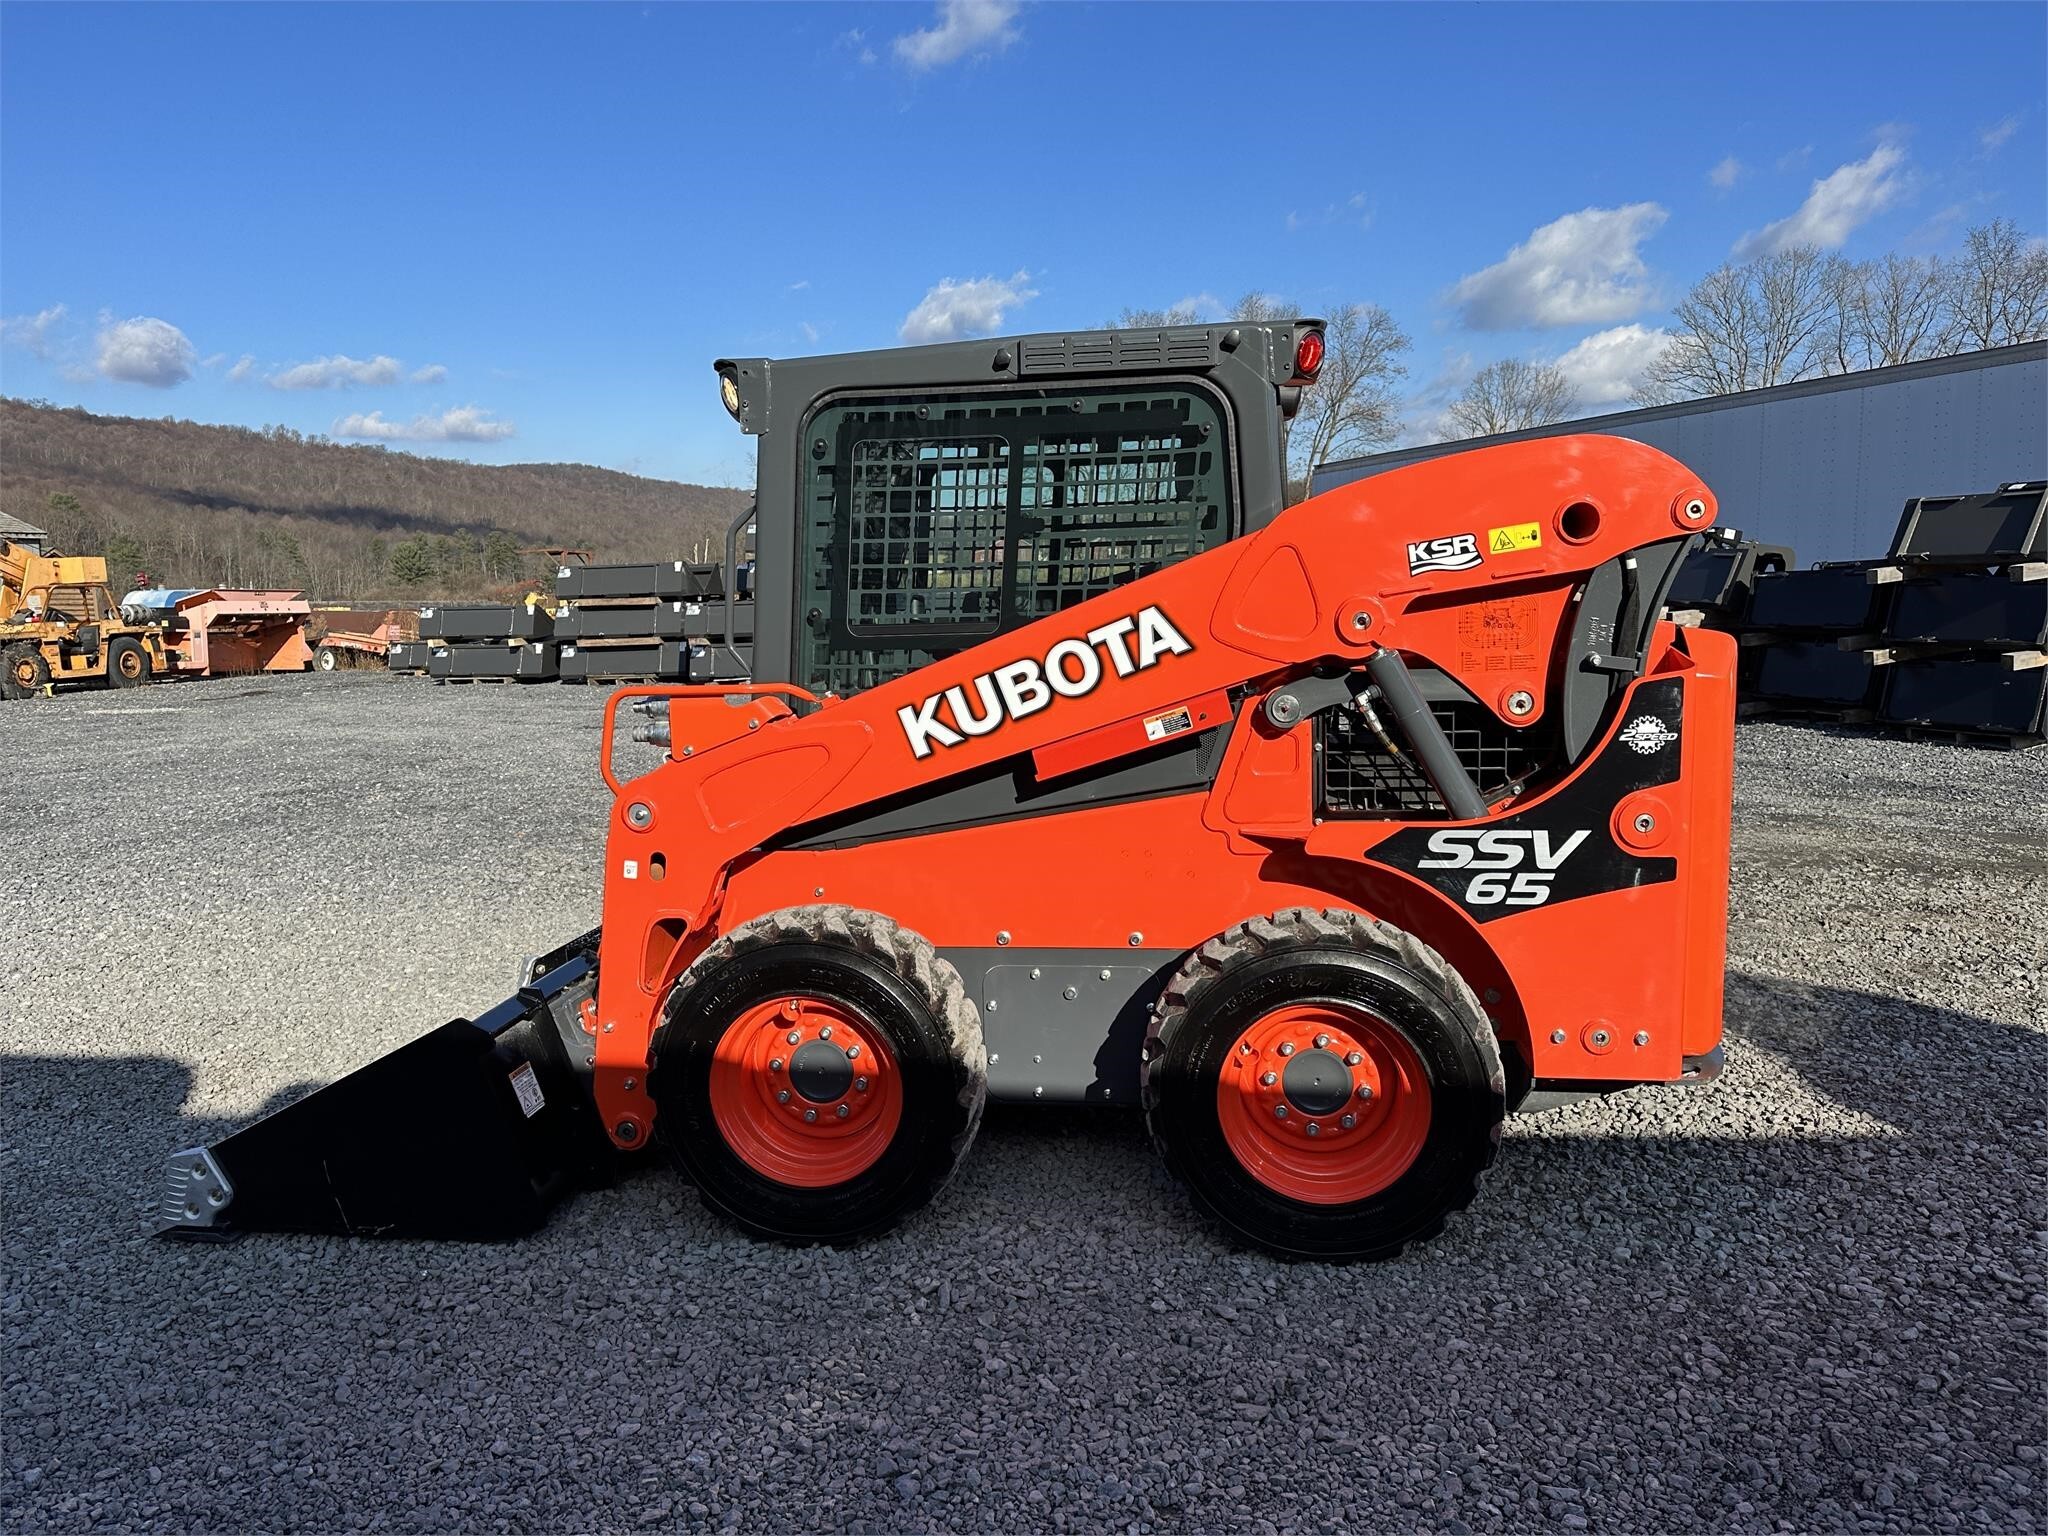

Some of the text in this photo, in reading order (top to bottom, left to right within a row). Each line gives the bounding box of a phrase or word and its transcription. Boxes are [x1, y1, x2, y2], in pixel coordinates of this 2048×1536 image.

[1408, 534, 1477, 563] KSR
[897, 605, 1193, 759] KUBOTA
[1417, 829, 1592, 869] SSV
[1465, 872, 1555, 905] 65
